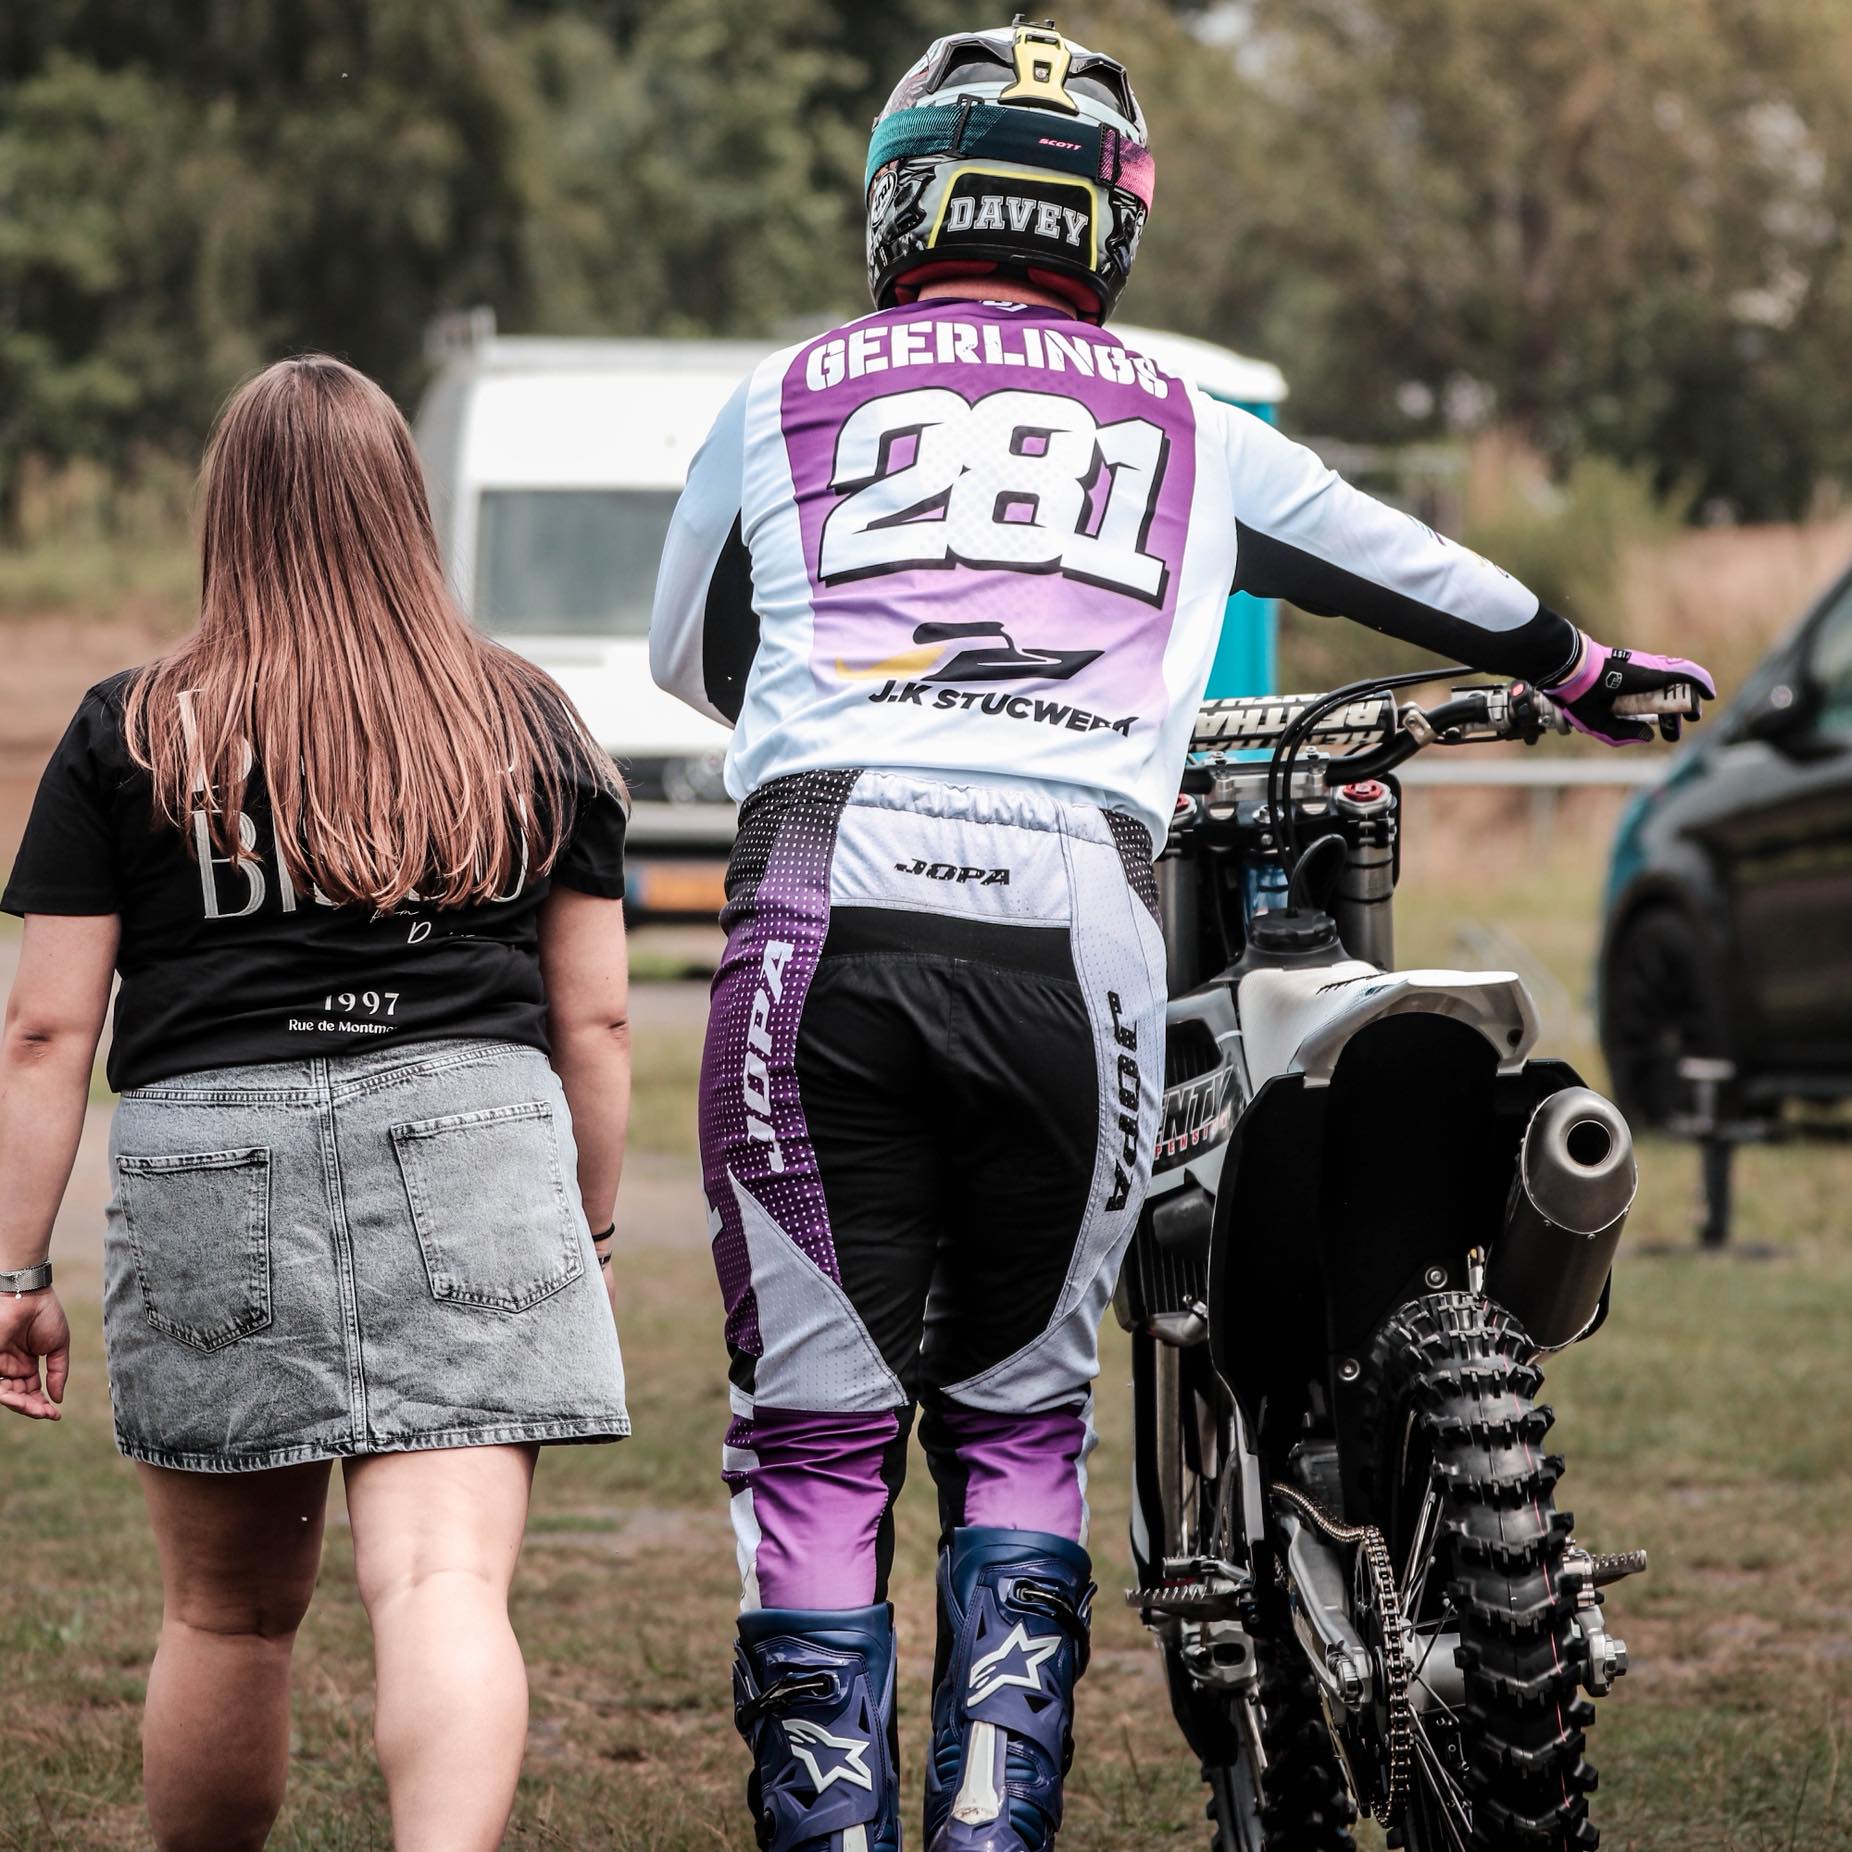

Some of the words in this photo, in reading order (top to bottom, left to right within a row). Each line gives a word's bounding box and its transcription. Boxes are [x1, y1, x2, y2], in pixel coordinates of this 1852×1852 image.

[1038, 138, 1082, 150] SCOTT
[947, 196, 1088, 246] DAVEY
[806, 321, 1169, 399] GEERLINGS
[817, 385, 1171, 610] 281
[868, 679, 932, 705] J.K
[894, 858, 1011, 886] JOPA
[324, 991, 400, 1016] 1997
[288, 1019, 314, 1031] Rue
[317, 1020, 335, 1032] de
[743, 939, 795, 1174] JOPA
[1104, 990, 1141, 1212] JOPA
